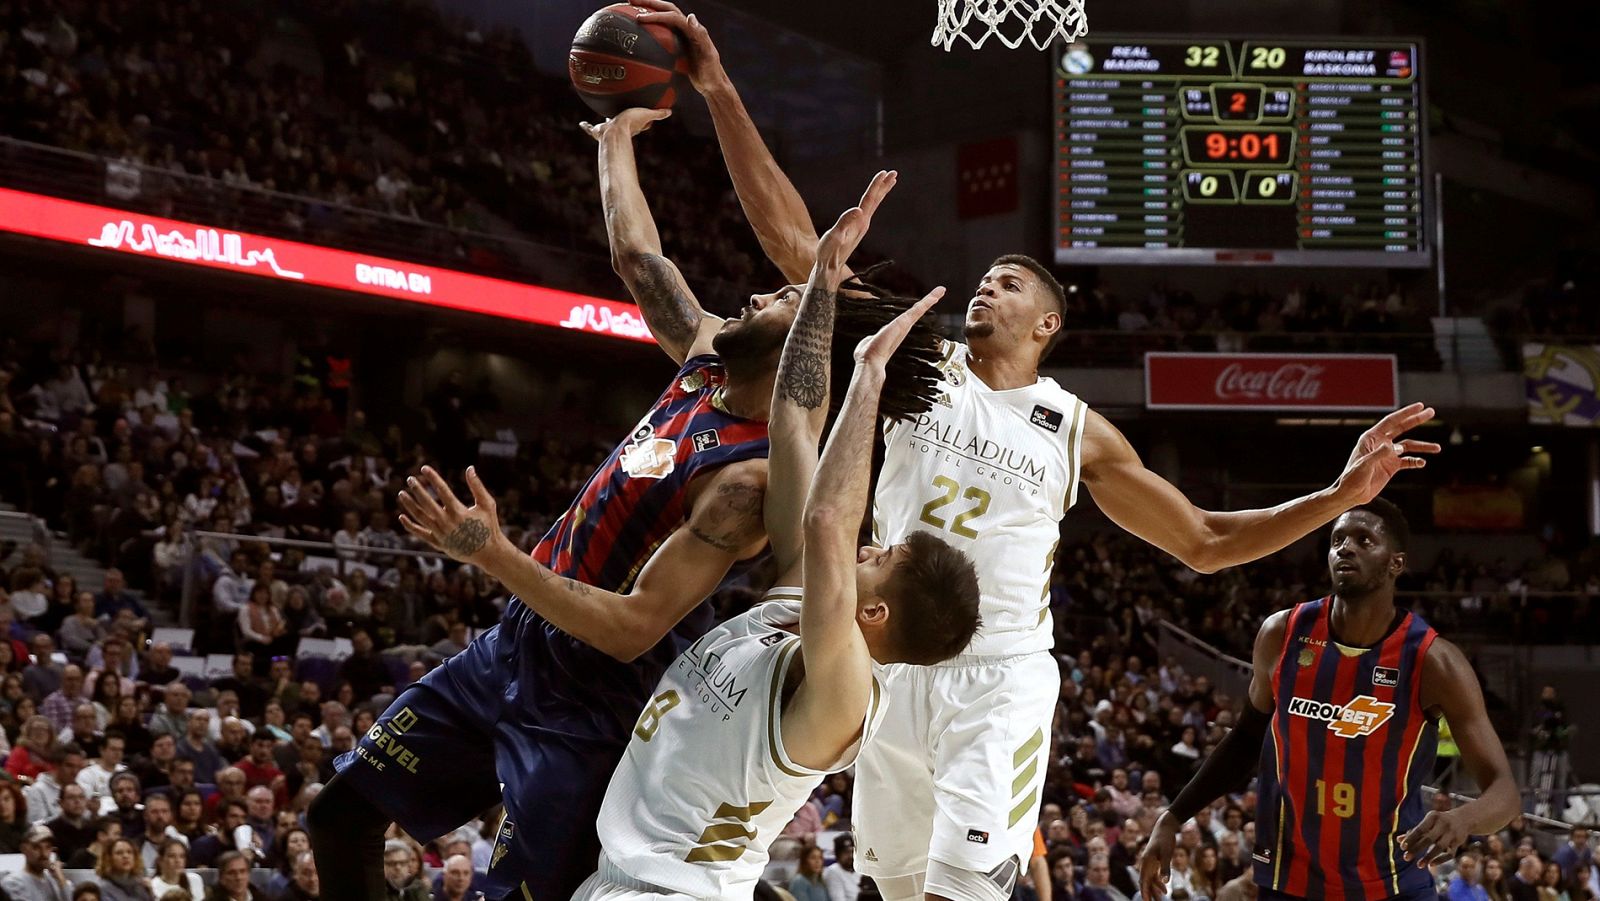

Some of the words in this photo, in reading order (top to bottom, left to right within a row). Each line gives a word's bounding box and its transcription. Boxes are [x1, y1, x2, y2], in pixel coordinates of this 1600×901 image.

[1112, 46, 1150, 58] REAL
[1185, 46, 1220, 67] 32
[1251, 47, 1286, 69] 20
[1304, 50, 1375, 63] KIROLBET
[1103, 59, 1160, 71] MADRID
[1303, 63, 1377, 76] BASKONIA
[1230, 92, 1247, 112] 2
[1205, 133, 1278, 159] 9:01
[1200, 176, 1218, 197] 0
[1259, 177, 1277, 198] 0
[355, 263, 408, 290] ENTRA
[408, 272, 432, 294] EN
[915, 414, 1046, 483] PALLADIUM
[909, 440, 961, 468] HOTEL
[976, 466, 1039, 496] GROUP
[919, 474, 991, 540] 22
[1299, 636, 1328, 648] KELME
[1290, 698, 1379, 726] KIROLBET
[367, 722, 420, 774] GEVEL
[1315, 779, 1355, 818] 19
[968, 833, 984, 843] acb
